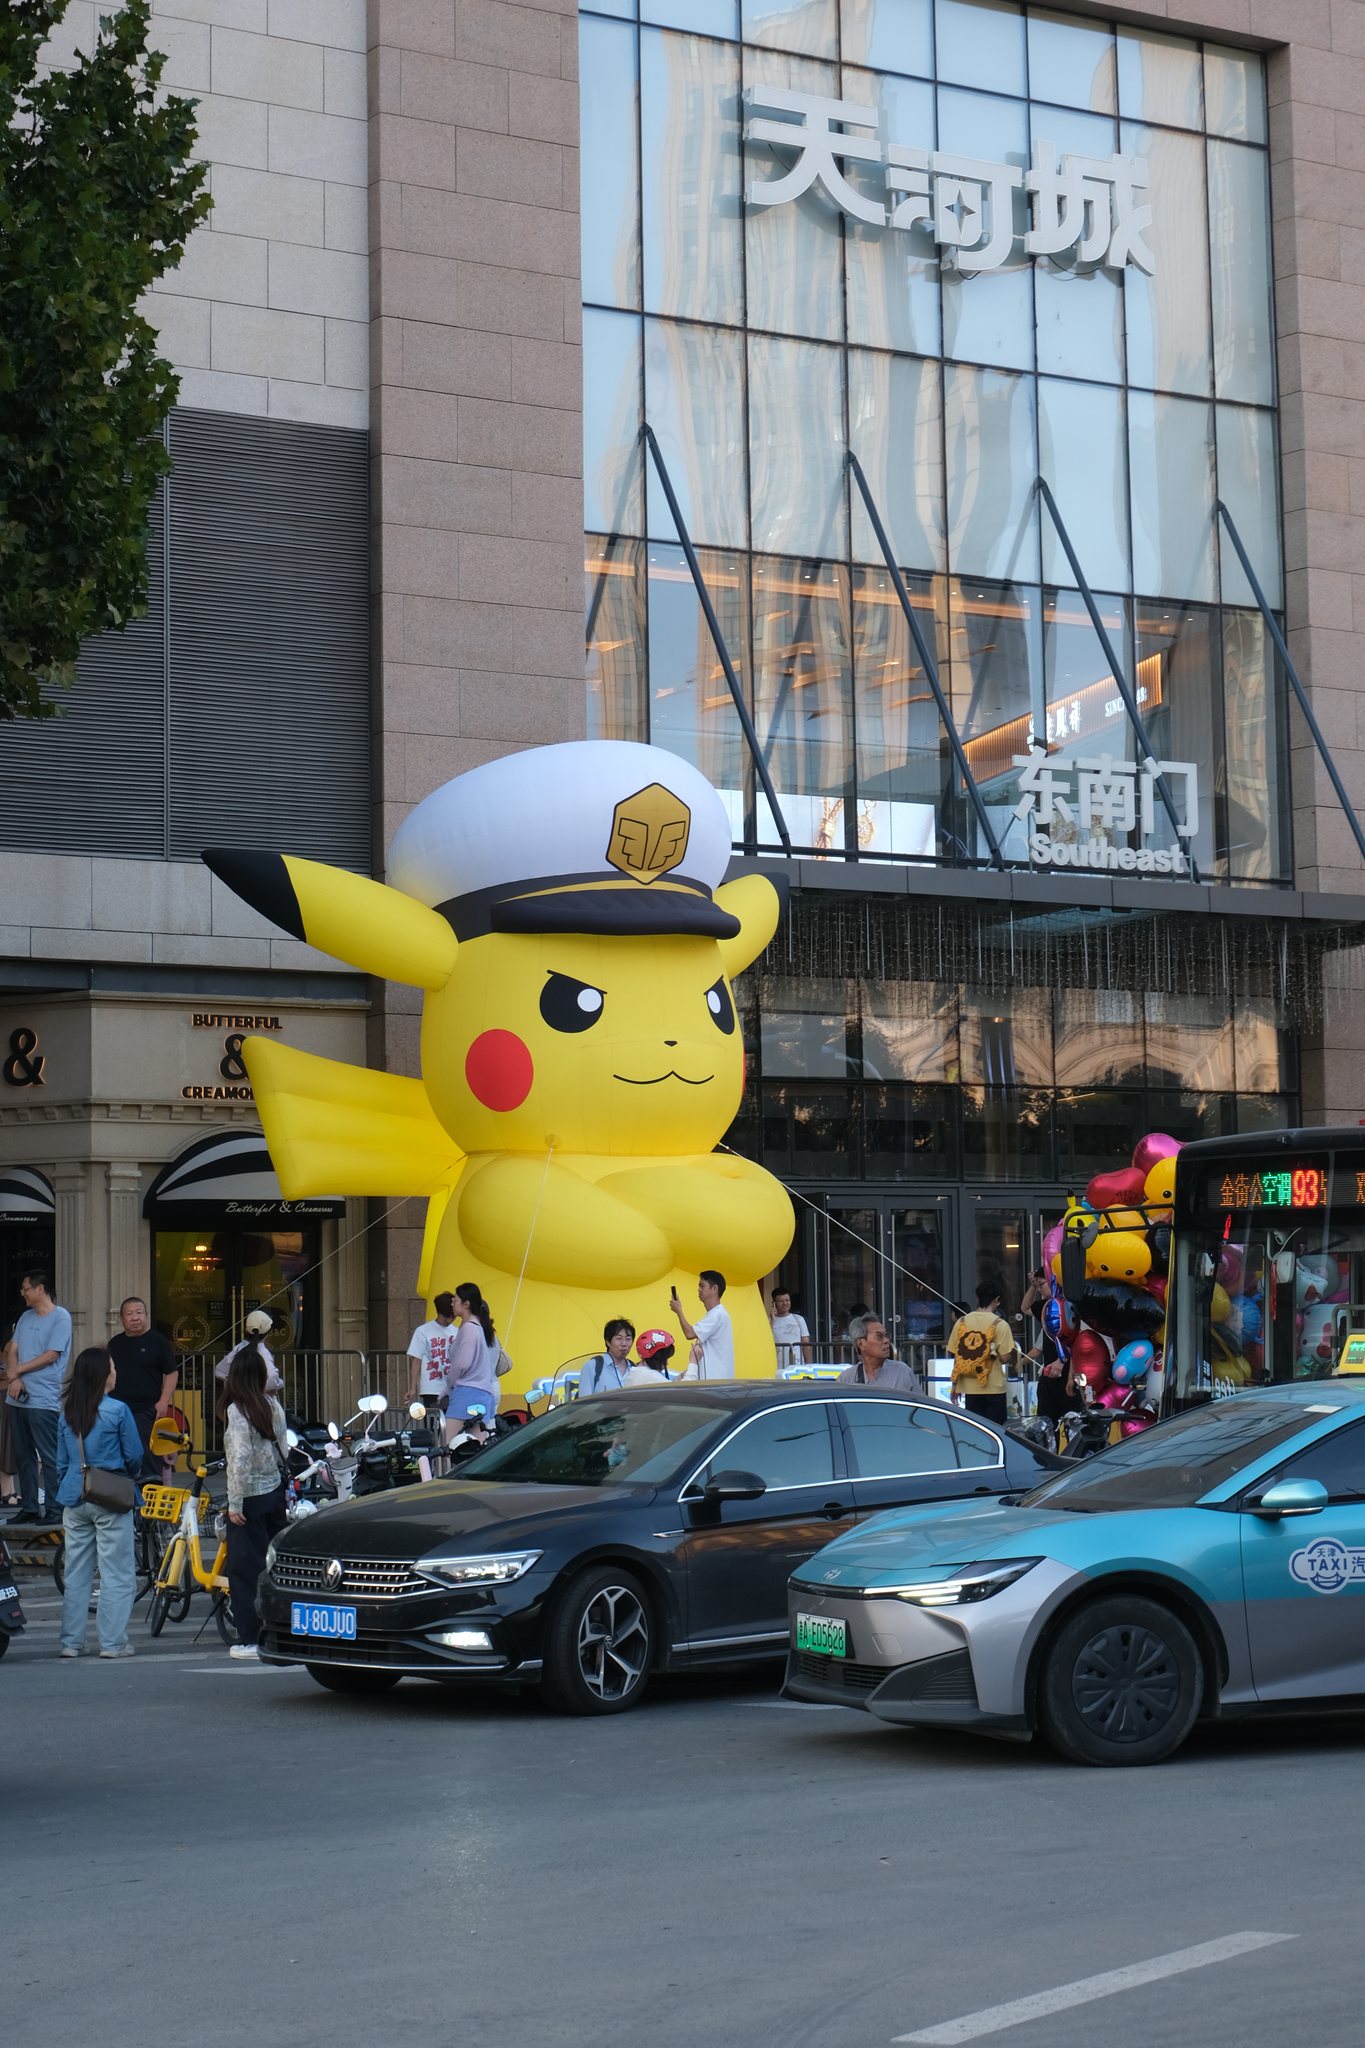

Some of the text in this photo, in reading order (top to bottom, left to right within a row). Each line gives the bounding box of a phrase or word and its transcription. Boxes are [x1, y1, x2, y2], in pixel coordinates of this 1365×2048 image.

[744, 84, 1155, 276] 天河城
[1012, 746, 1199, 837] 东南门
[1029, 832, 1185, 874] Southeast
[192, 1013, 283, 1030] BUTTERFUL
[3, 1028, 46, 1087] &
[219, 1033, 249, 1081] &
[225, 1202, 276, 1216] Butterful
[279, 1201, 292, 1213] &
[1308, 1558, 1348, 1571] TAXI
[1317, 1548, 1336, 1557] 天津
